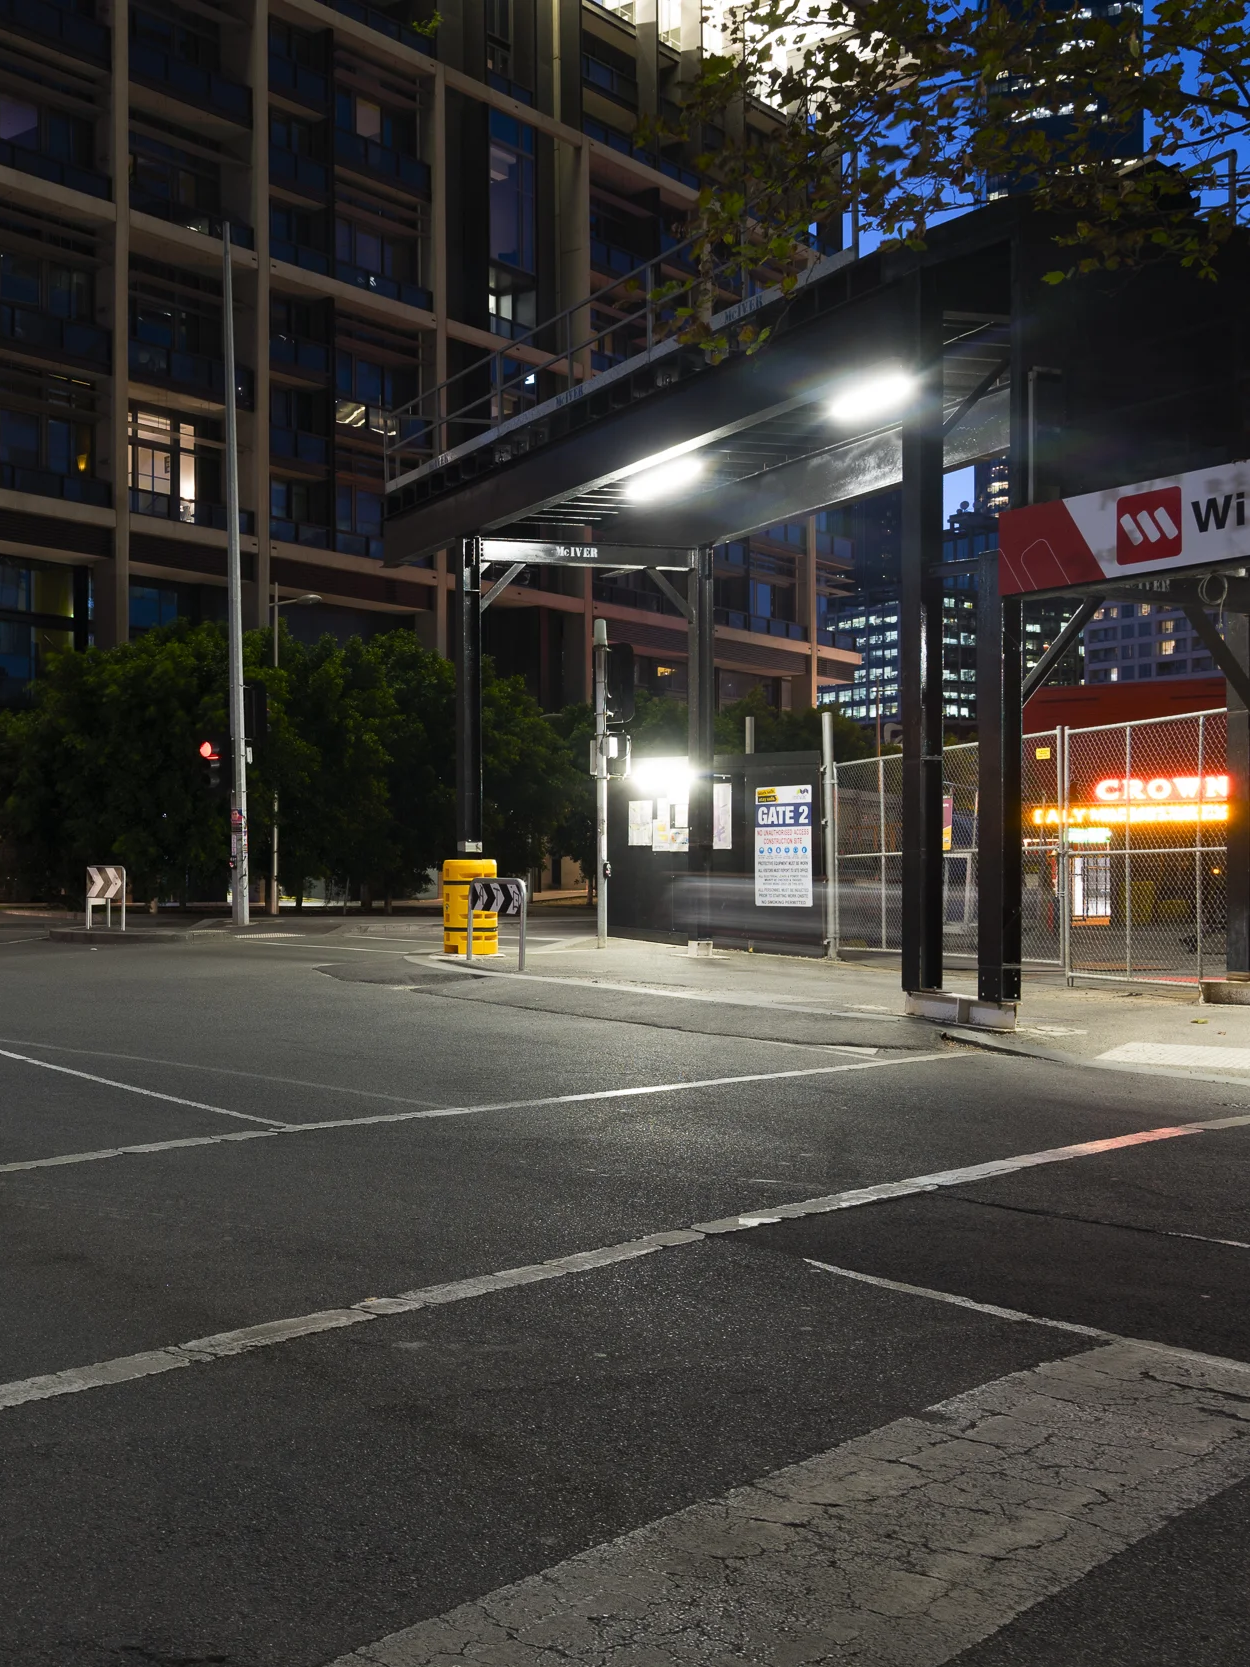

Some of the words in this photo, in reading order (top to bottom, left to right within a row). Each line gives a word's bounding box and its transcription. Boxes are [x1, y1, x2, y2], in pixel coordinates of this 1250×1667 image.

[1191, 492, 1245, 533] Wi
[556, 546, 598, 558] McIVER
[1096, 776, 1228, 801] CROWN
[758, 806, 794, 825] GATE
[799, 805, 809, 824] 2
